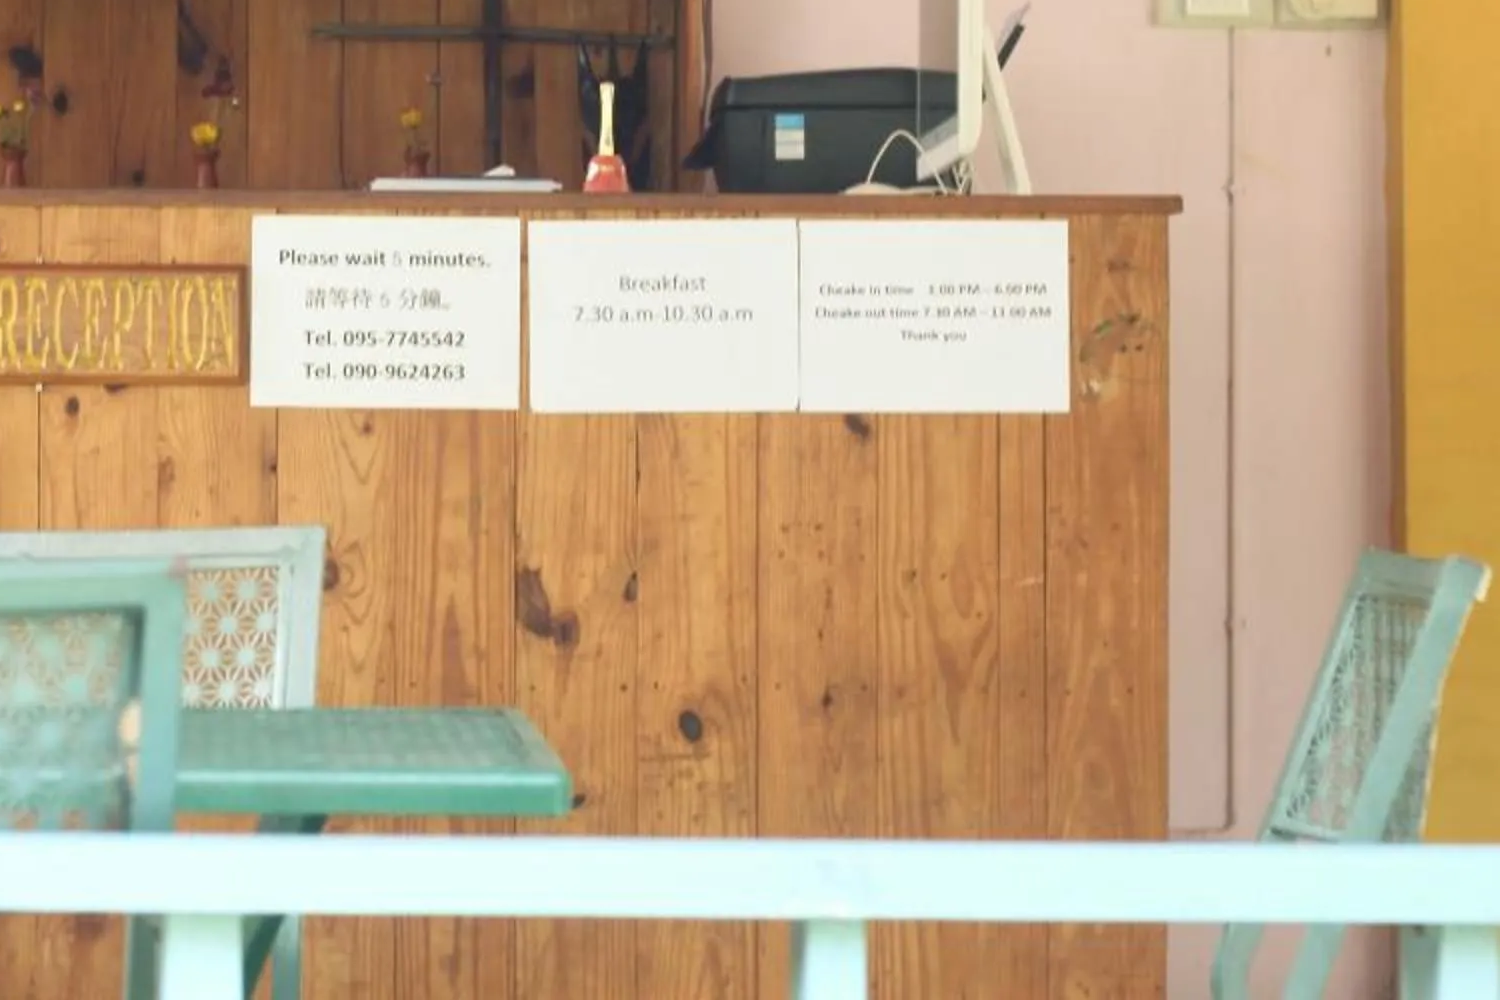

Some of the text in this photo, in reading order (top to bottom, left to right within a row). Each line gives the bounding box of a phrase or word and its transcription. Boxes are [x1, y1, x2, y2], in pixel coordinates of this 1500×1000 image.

[279, 249, 339, 266] Please
[345, 250, 386, 267] wait
[409, 251, 492, 268] minutes.
[619, 274, 707, 293] Breakfast
[889, 306, 919, 318] time
[953, 306, 976, 318] AM
[1029, 306, 1051, 318] AM
[305, 329, 466, 349] Tel. 095-7745542
[901, 329, 967, 344] Thank you
[304, 362, 467, 381] Tel. 090-9624263
